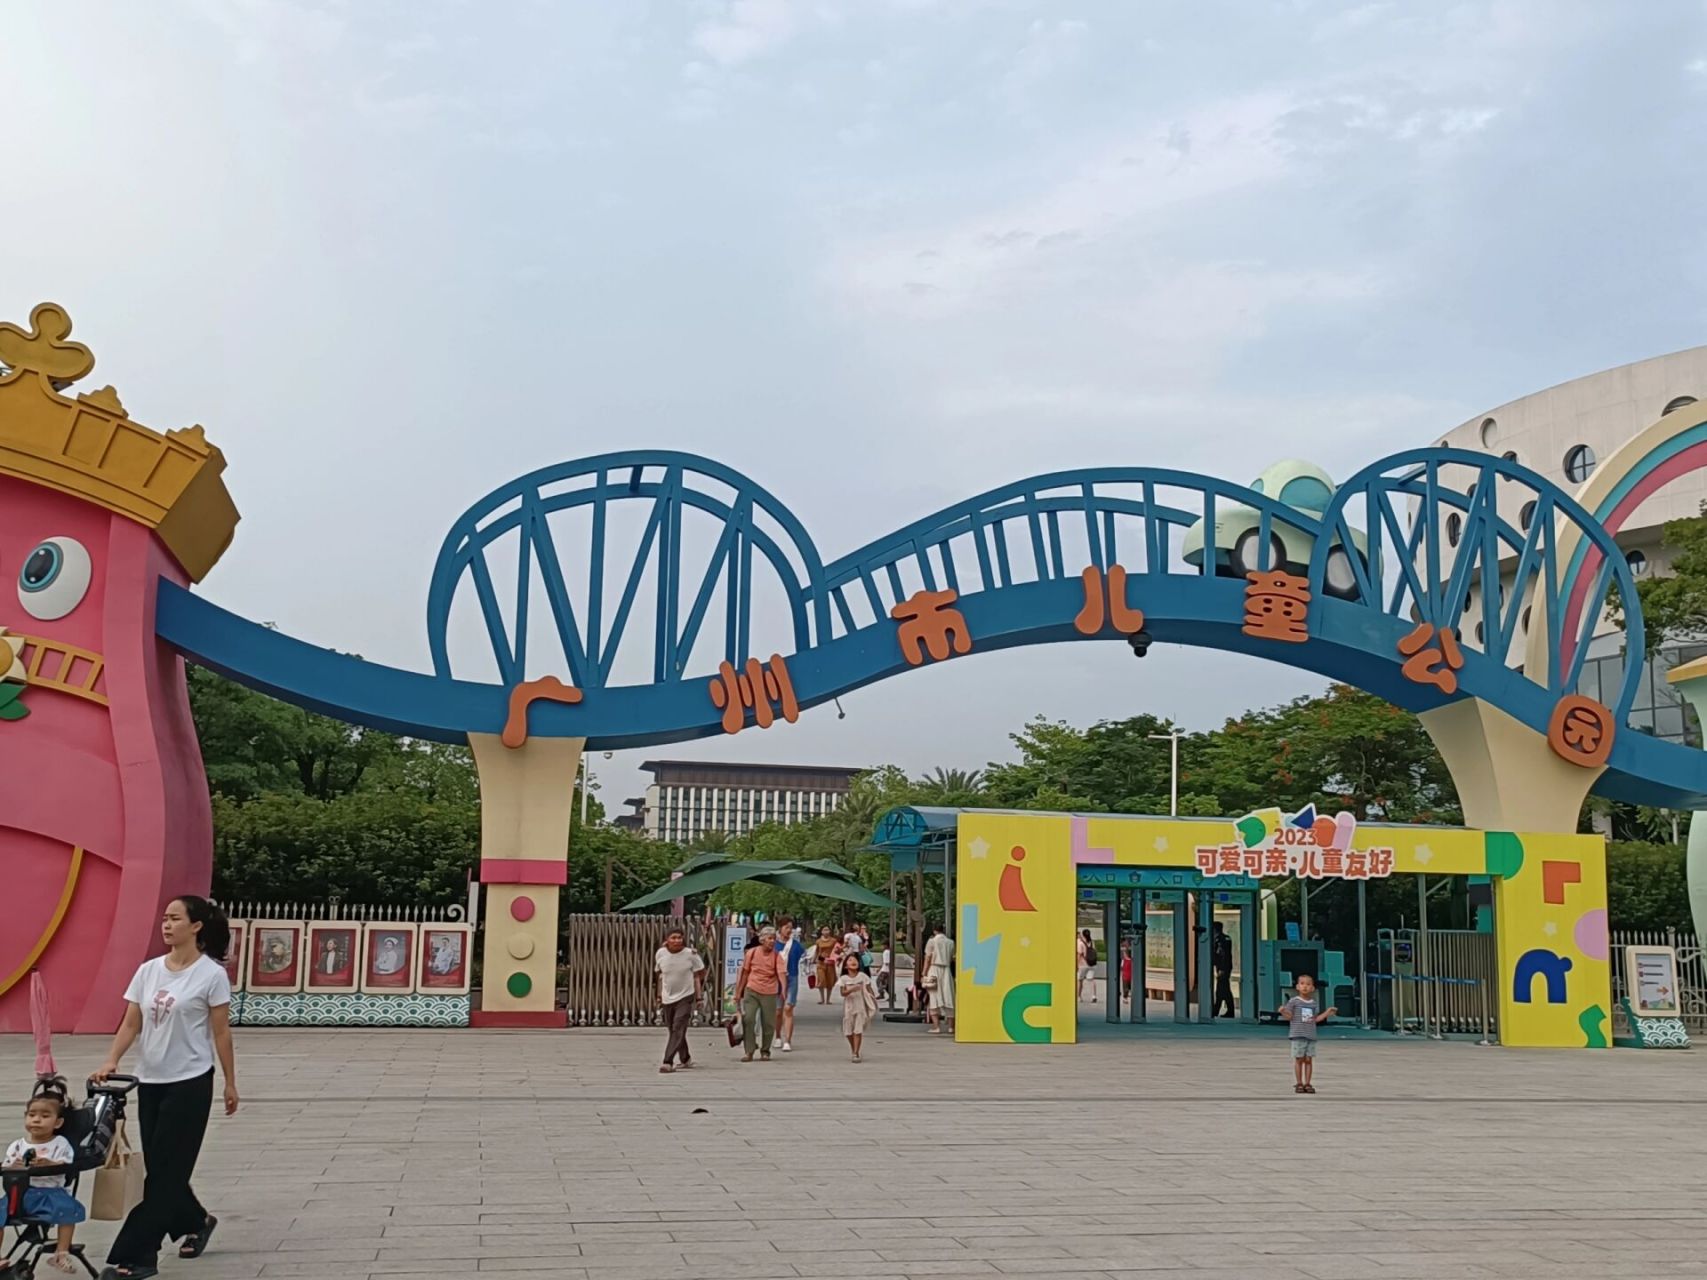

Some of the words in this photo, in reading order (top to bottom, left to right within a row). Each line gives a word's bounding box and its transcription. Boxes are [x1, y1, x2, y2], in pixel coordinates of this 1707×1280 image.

[502, 564, 1616, 769] 广州市儿童公园
[1274, 828, 1317, 846] 2023
[1197, 845, 1393, 877] 可爱可亲·儿童友好
[1154, 874, 1183, 885] 入口
